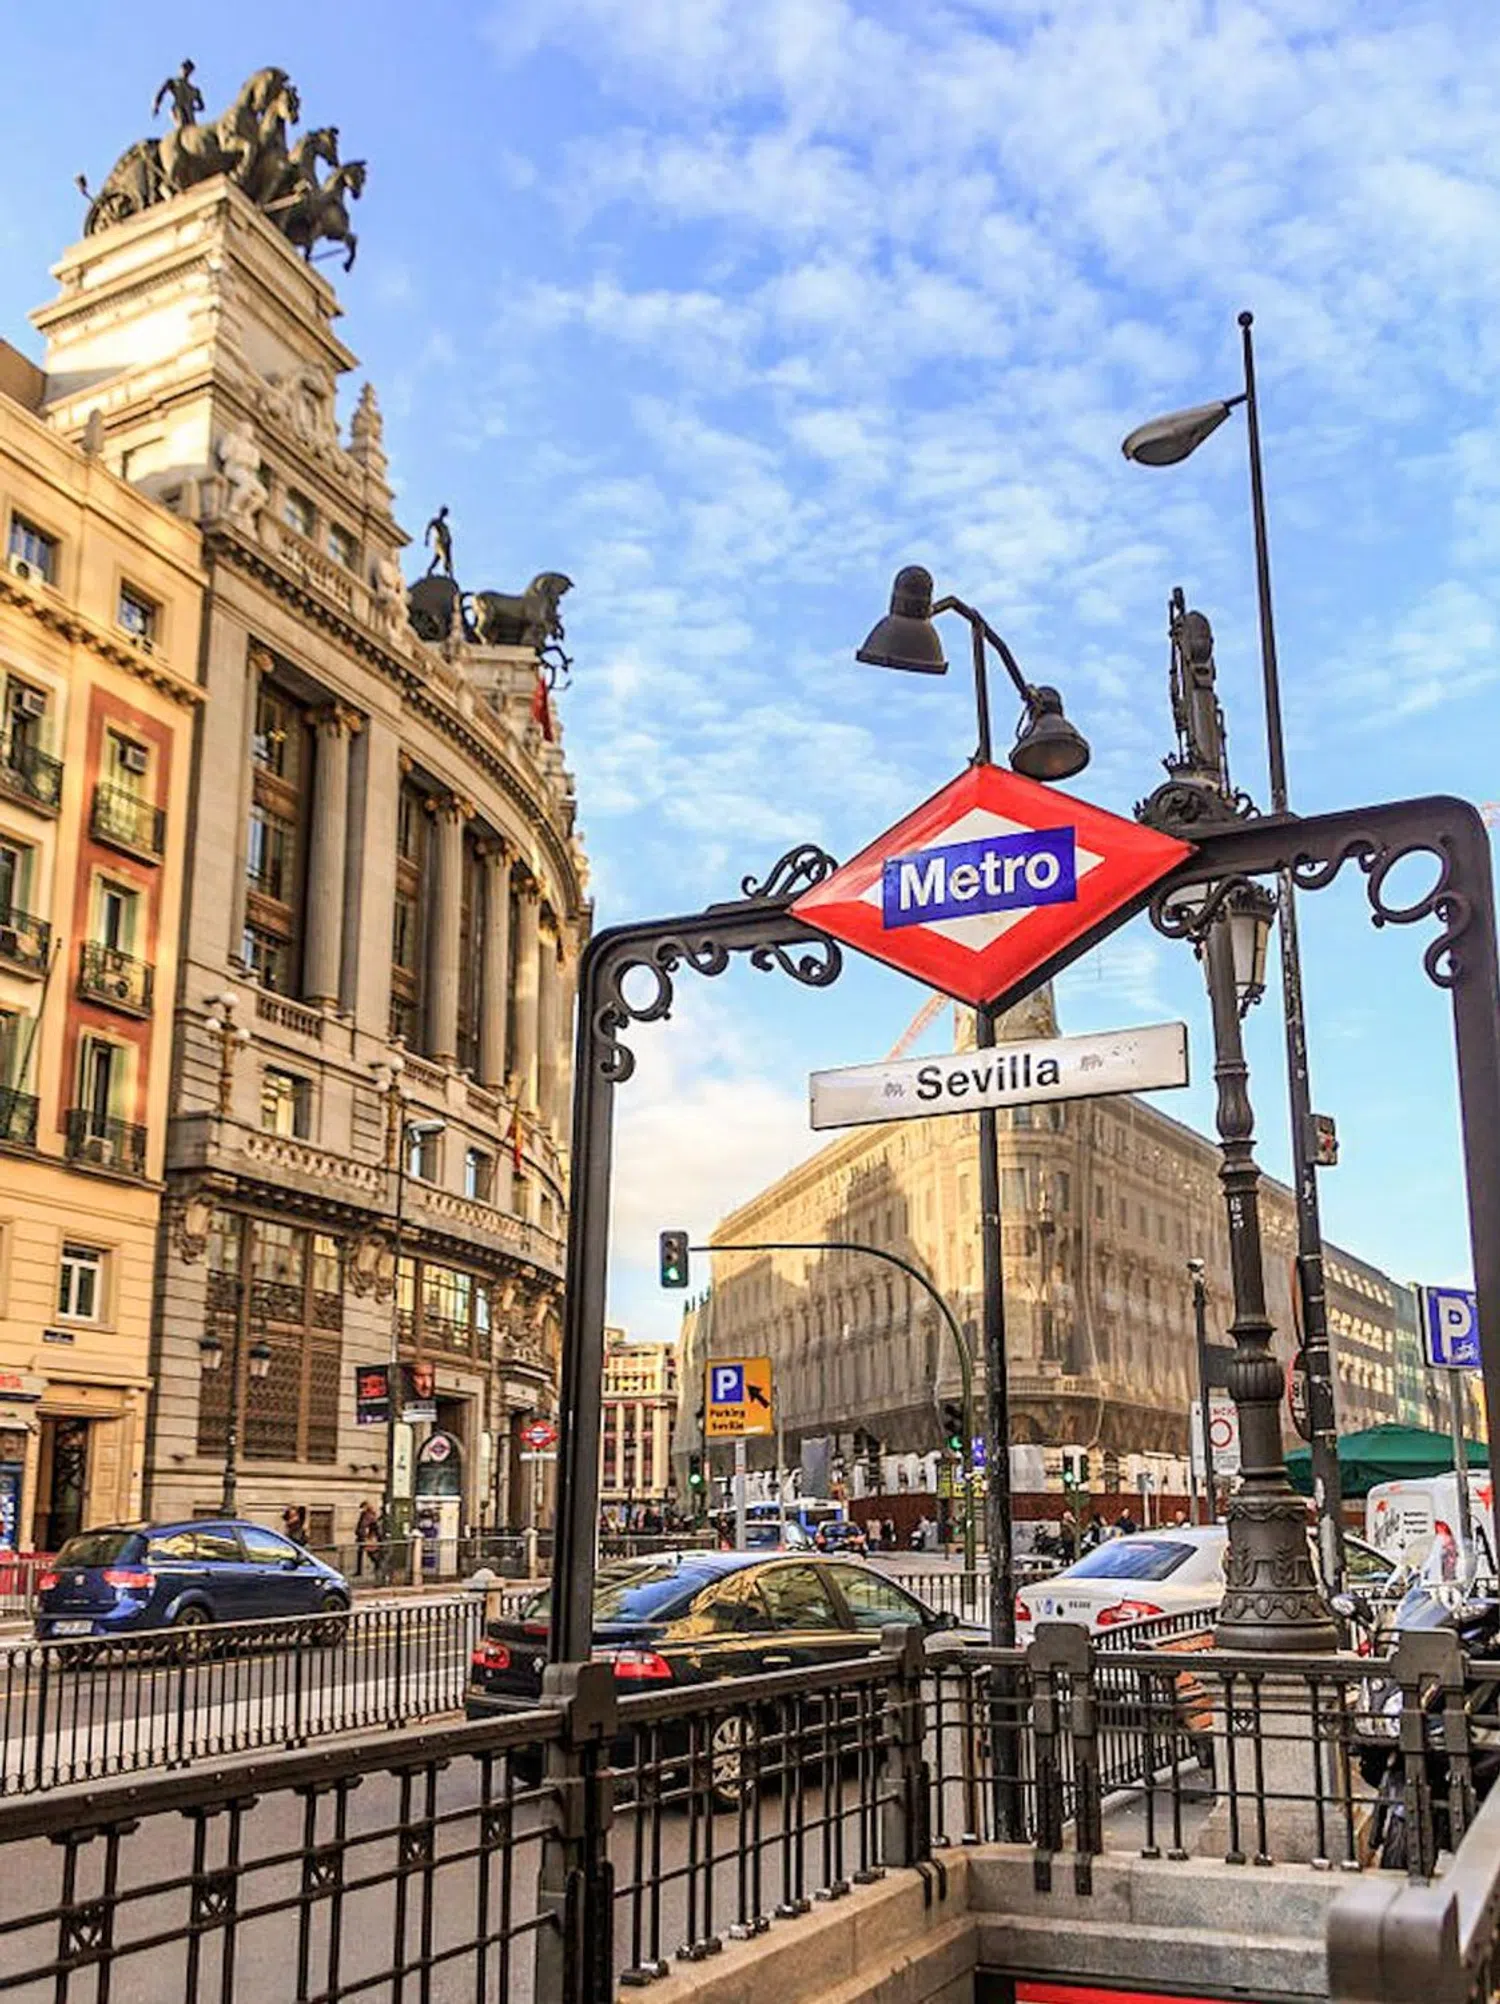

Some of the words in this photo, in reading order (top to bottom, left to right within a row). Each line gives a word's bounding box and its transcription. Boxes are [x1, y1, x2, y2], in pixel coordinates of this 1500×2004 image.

[899, 849, 1060, 911] Metro
[916, 1053, 1060, 1101] Sevilla
[1437, 1296, 1472, 1362] P
[717, 1368, 738, 1400] P
